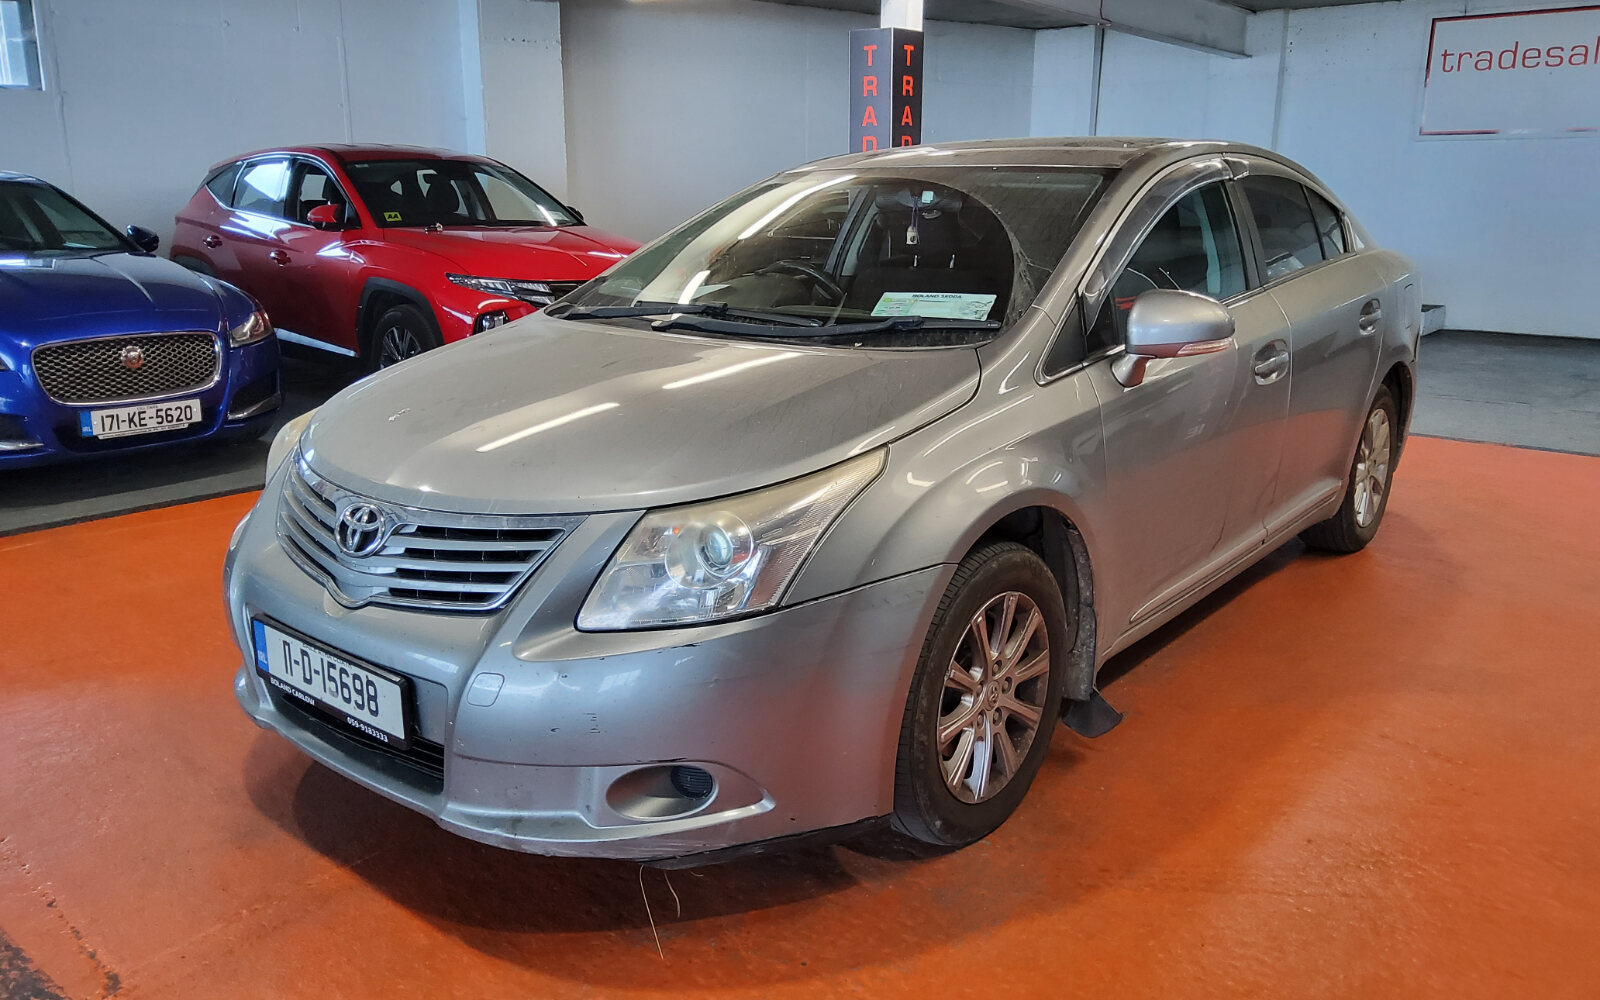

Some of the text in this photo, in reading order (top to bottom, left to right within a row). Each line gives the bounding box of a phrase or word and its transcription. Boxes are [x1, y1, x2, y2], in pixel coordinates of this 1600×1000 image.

[101, 405, 193, 432] 171-KE-5620
[270, 677, 292, 696] BOLAND
[282, 640, 379, 717] 11-D-15698
[346, 716, 389, 742] 059-9183333
